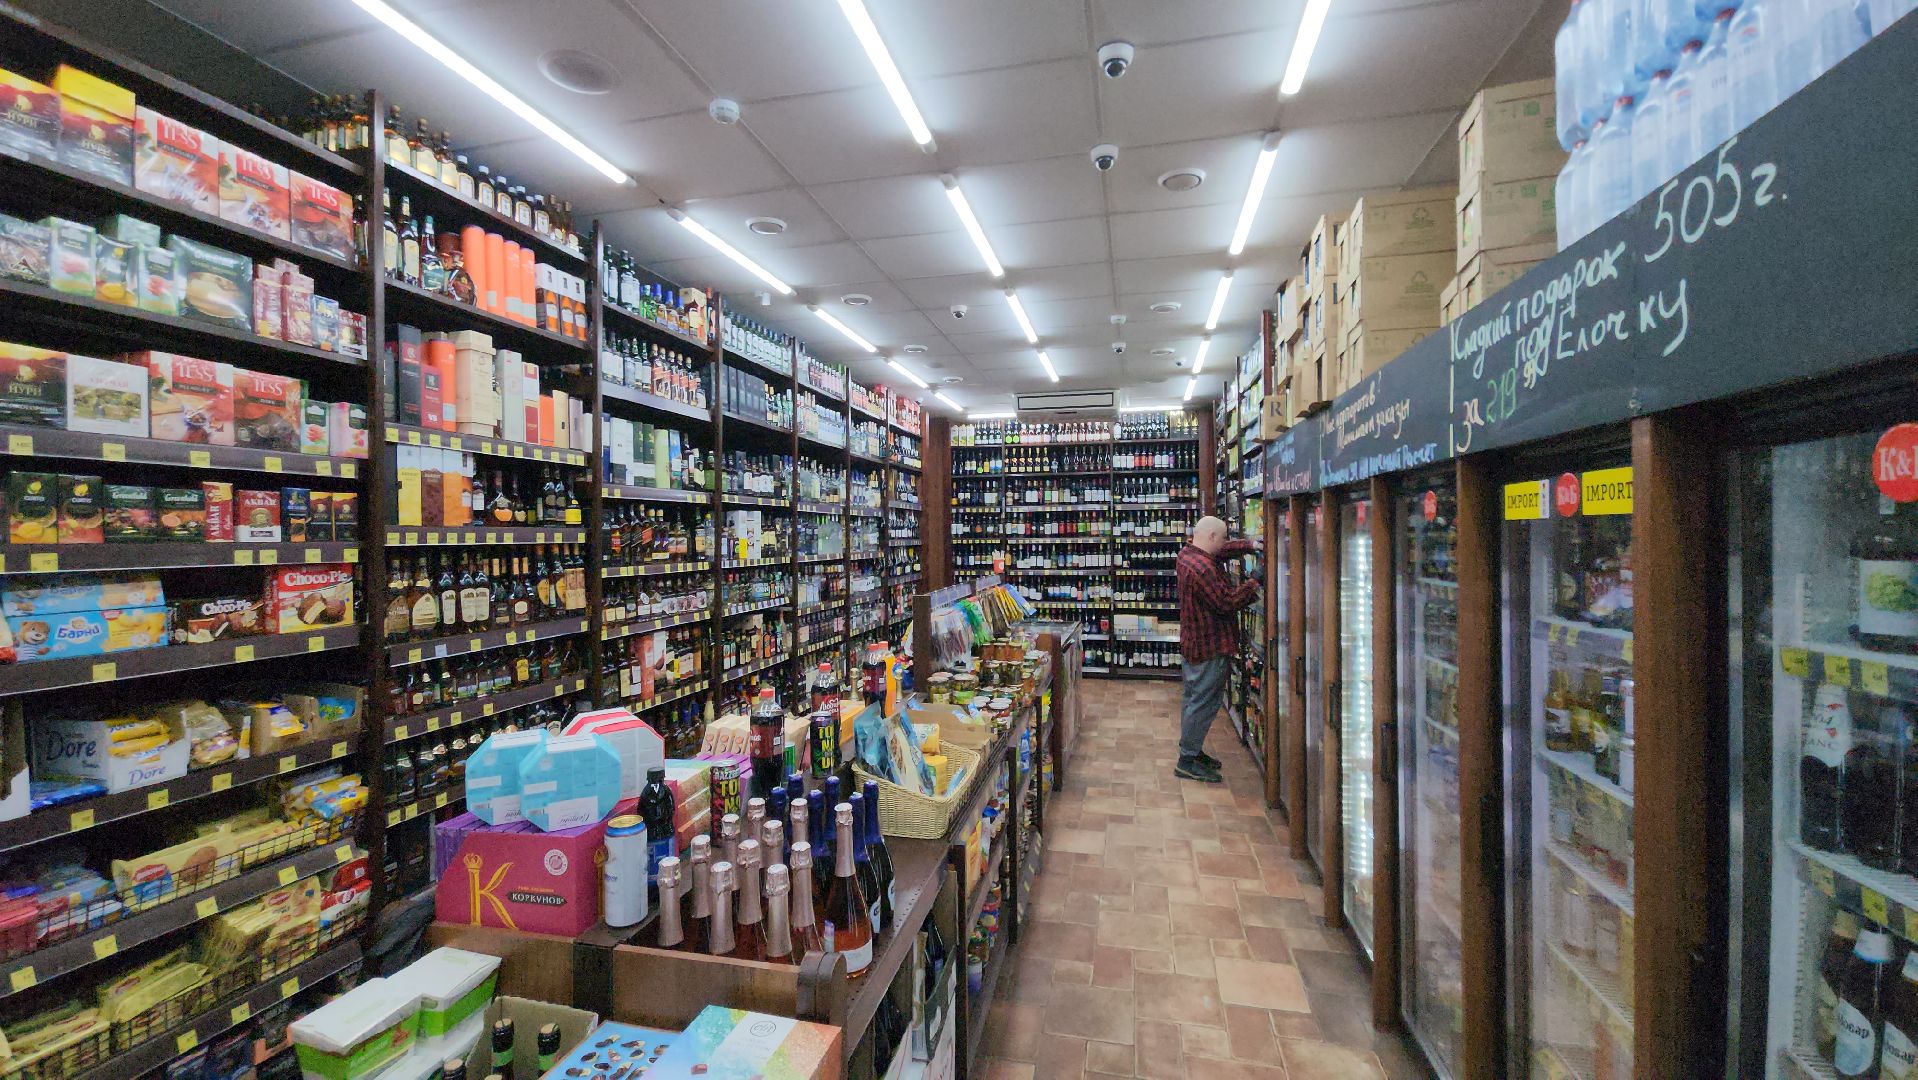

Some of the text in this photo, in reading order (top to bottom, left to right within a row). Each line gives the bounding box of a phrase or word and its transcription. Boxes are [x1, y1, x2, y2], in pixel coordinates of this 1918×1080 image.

[176, 360, 214, 383] TESS
[255, 377, 283, 397] TESS
[1587, 482, 1633, 501] IMPORT
[244, 498, 276, 507] AKBAR
[1507, 493, 1539, 509] IMPORT
[56, 624, 101, 640] Барни
